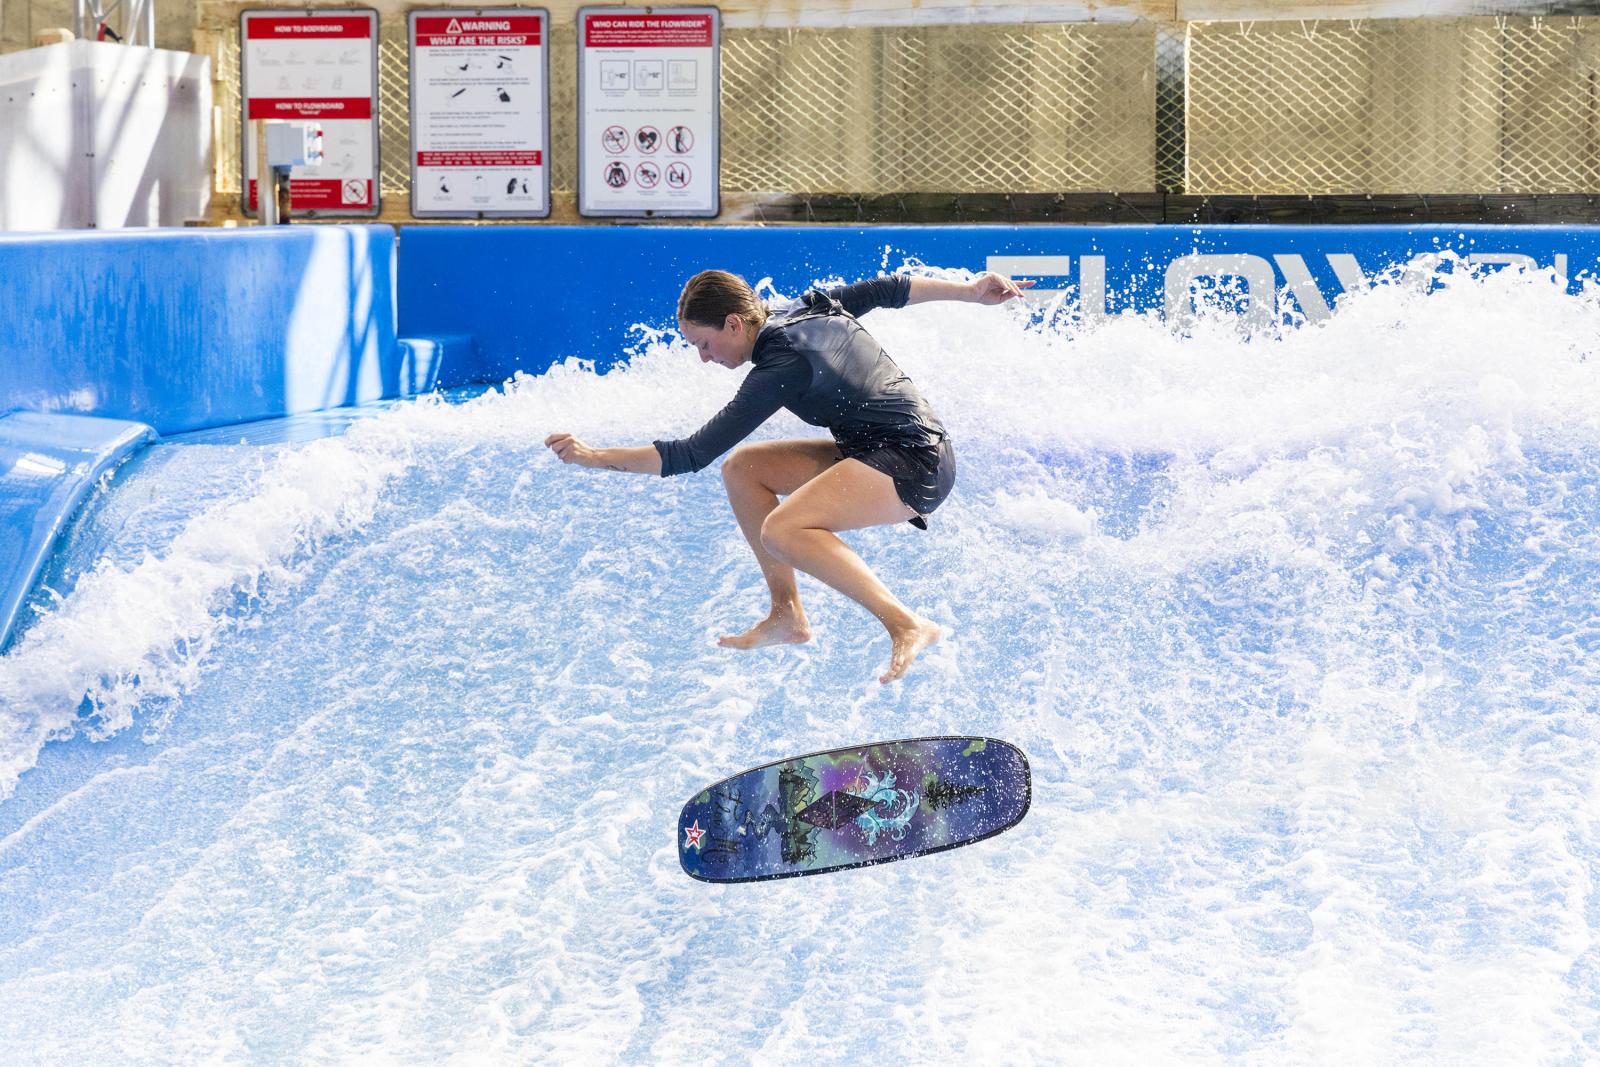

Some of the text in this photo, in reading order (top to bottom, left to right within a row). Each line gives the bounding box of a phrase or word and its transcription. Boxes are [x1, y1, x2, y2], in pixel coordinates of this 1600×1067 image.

[461, 21, 511, 31] WARNING
[592, 20, 611, 28] WHO
[612, 20, 628, 28] CAN
[628, 20, 645, 28] RIDE
[646, 20, 660, 28] THE
[274, 25, 292, 33] HOW
[293, 25, 302, 33] TO
[429, 35, 528, 46] WHAT ARE THE RISKS?
[275, 102, 293, 110] HOW
[293, 102, 303, 110] TO
